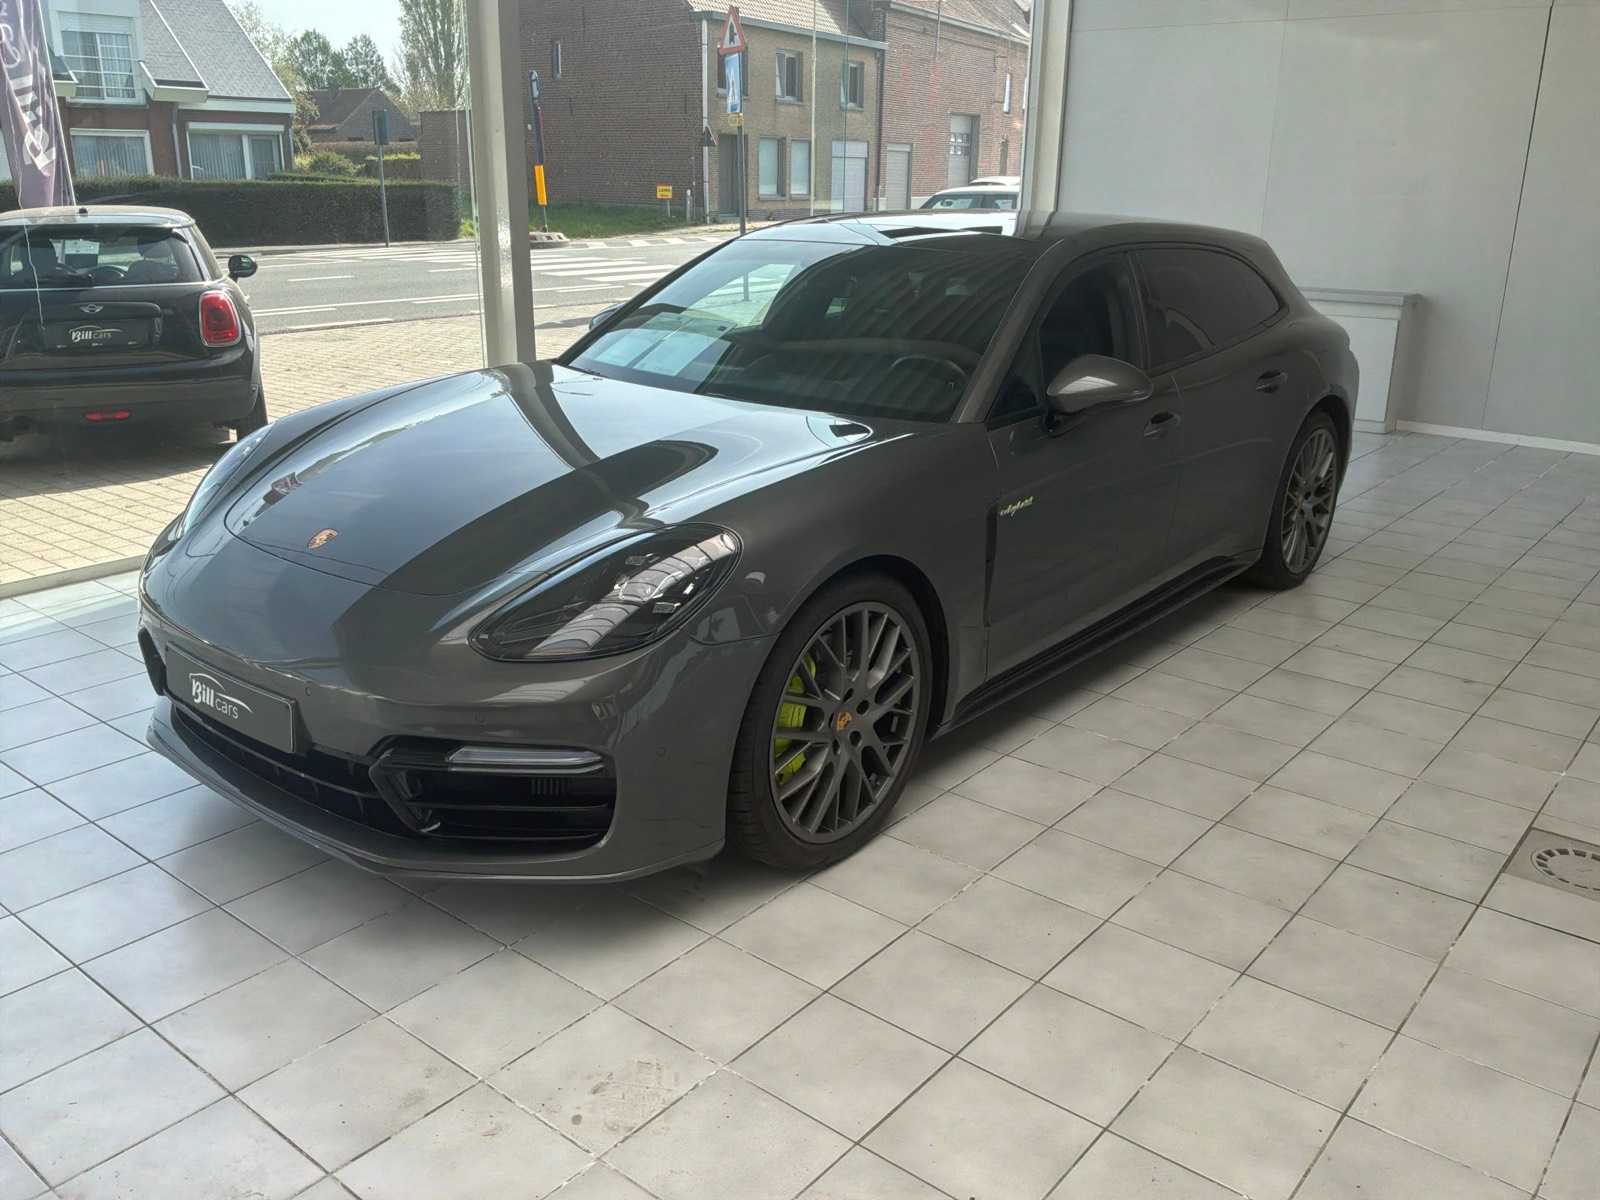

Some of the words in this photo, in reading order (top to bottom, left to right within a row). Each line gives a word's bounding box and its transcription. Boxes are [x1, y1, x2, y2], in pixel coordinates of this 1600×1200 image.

[71, 330, 93, 343] Bill
[93, 332, 113, 340] cars
[191, 678, 215, 708] Bill
[215, 698, 239, 719] cars
